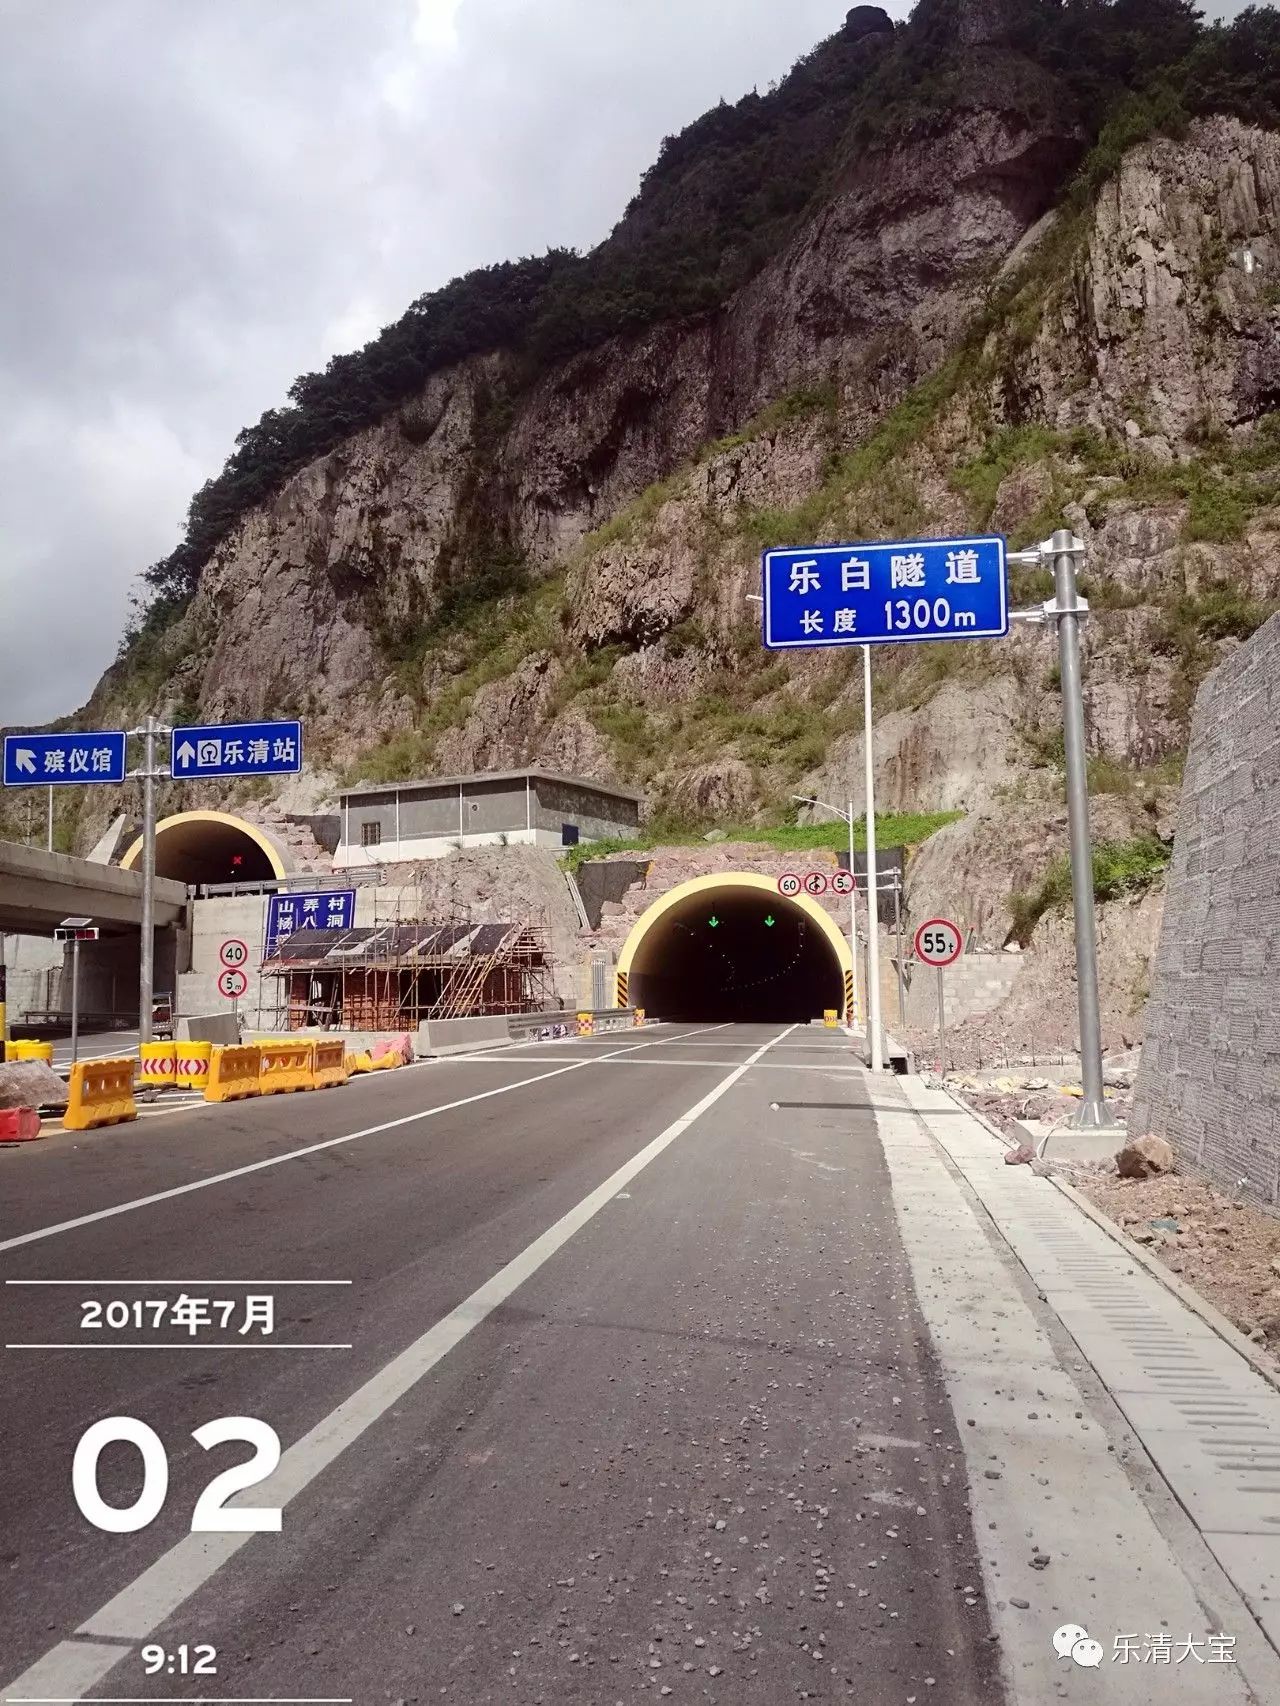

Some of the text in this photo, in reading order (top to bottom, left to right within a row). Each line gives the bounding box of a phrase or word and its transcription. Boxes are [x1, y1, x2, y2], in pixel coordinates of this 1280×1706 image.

[788, 549, 982, 595] 乐白隧道
[799, 597, 976, 635] 长度 1300m
[43, 747, 113, 774] 殡仪馆
[223, 737, 296, 766] 乐清站
[783, 880, 796, 891] 60
[279, 896, 346, 913] 山弄村
[225, 947, 243, 961] 40
[923, 932, 954, 953] 55t
